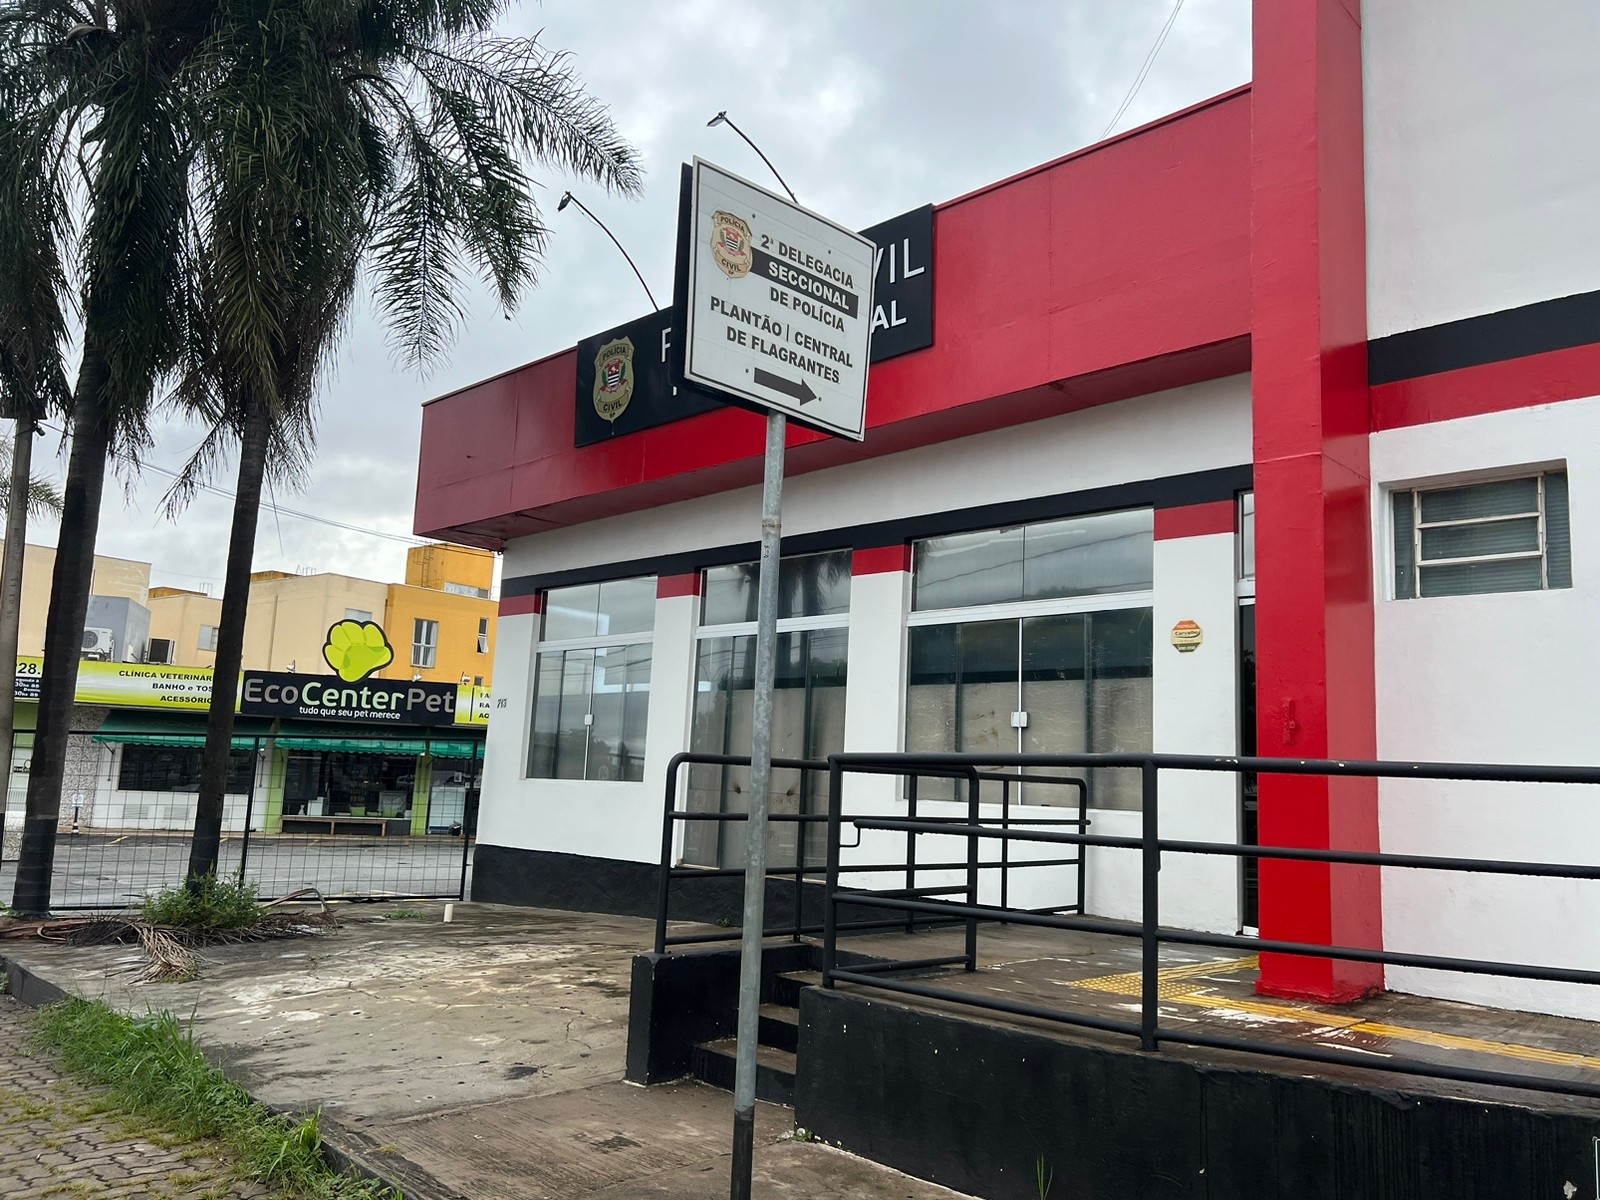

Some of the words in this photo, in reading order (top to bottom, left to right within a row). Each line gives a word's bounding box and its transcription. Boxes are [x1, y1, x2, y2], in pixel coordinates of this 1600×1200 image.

[721, 258, 742, 272] CIVIL
[779, 241, 854, 290] DELEGACIA
[768, 261, 850, 310] SECCIONAL
[770, 286, 789, 307] DE
[792, 296, 845, 333] POLÍCIA
[710, 295, 782, 337] PLANTÃO
[794, 331, 854, 368] CENTRAL
[726, 326, 747, 346] DE
[751, 335, 840, 384] FLAGRANTES
[603, 402, 623, 412] CIVIL
[118, 670, 157, 679] CLÍNICA
[152, 683, 186, 691] BANHO
[299, 706, 319, 715] tudo
[320, 708, 336, 717] que
[338, 708, 353, 717] seu
[354, 709, 368, 719] pet
[369, 711, 401, 720] merece
